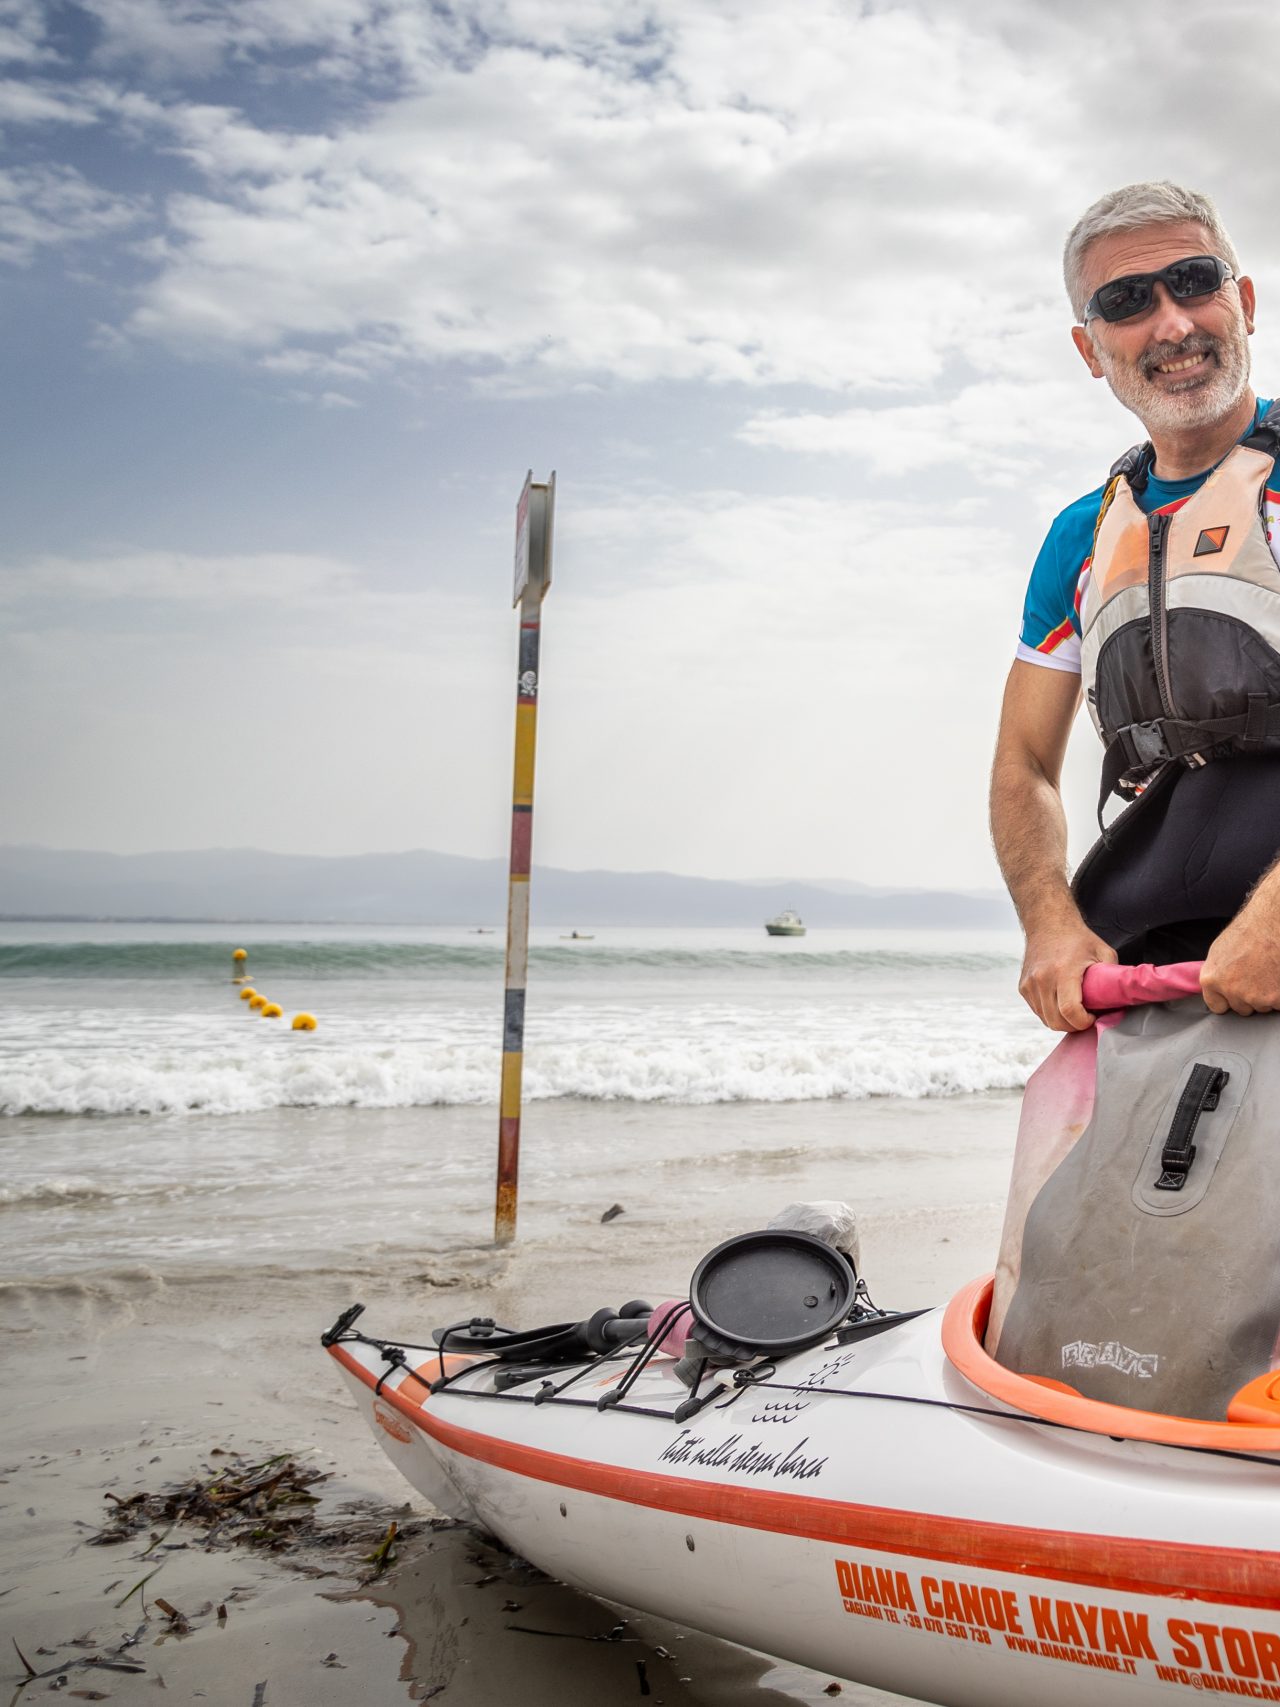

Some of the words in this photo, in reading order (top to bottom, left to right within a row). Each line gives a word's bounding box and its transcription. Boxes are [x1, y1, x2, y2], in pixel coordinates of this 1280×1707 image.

[658, 1429, 705, 1464] Tutti
[689, 1434, 743, 1467] nella
[728, 1442, 782, 1475] stessa
[773, 1437, 829, 1479] barca
[835, 1559, 917, 1612] DIANA
[920, 1576, 1024, 1635] CANOE
[1029, 1595, 1159, 1661] KAYAK
[843, 1599, 883, 1620] CAGLIARI
[884, 1608, 900, 1624] TEL
[903, 1613, 922, 1629] +39
[923, 1617, 944, 1634] 070
[945, 1622, 968, 1640] 530
[969, 1627, 992, 1645] 738
[1004, 1634, 1137, 1676] WWW.DIANACANOE.IT
